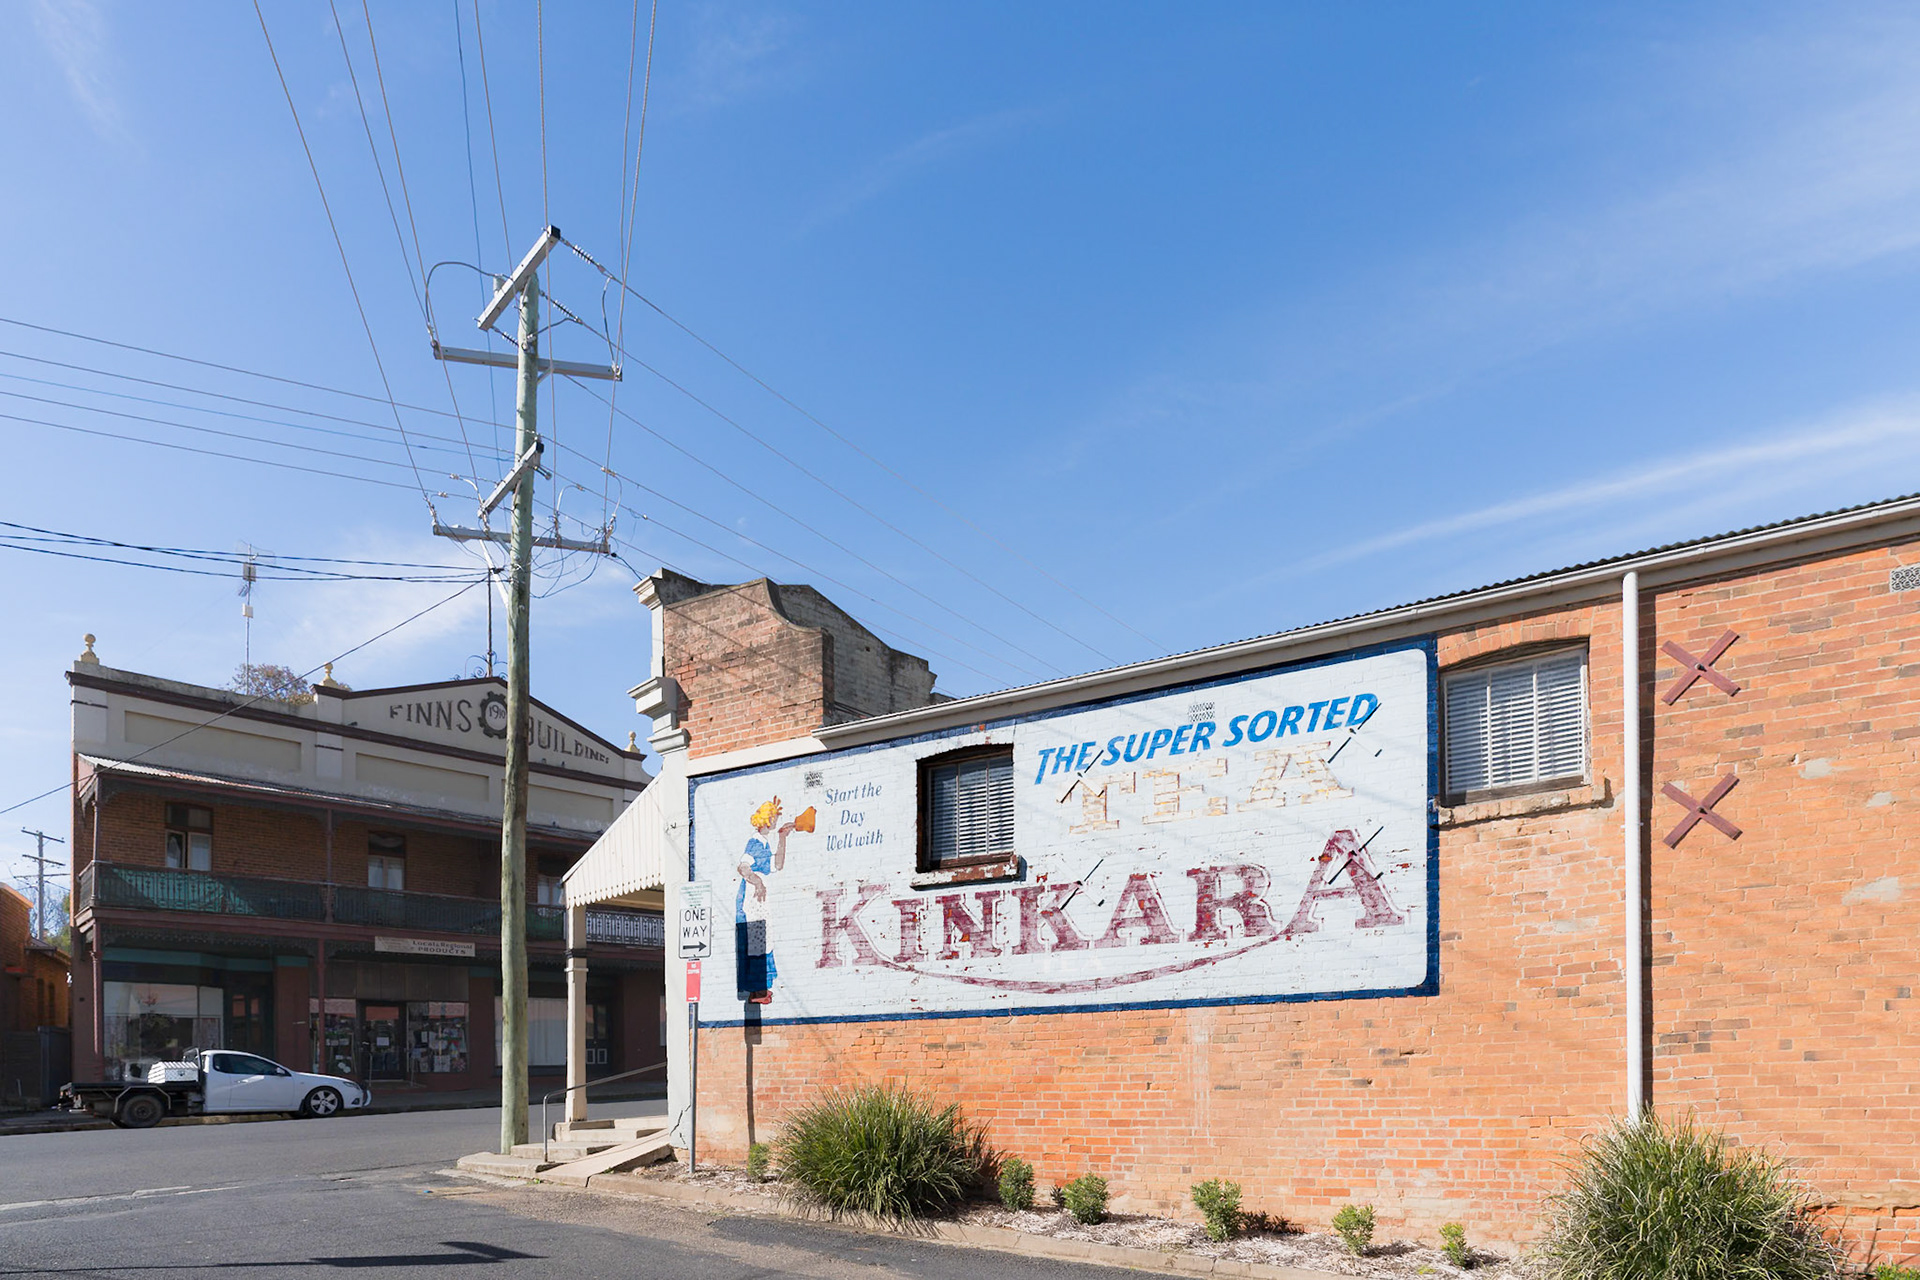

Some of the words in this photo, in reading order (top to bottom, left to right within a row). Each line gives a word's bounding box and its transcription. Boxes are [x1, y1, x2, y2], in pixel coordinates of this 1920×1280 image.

[389, 699, 473, 733] FINNS
[1035, 741, 1097, 785] THE
[1100, 721, 1217, 768] SUPER
[1222, 692, 1380, 747] SORTED
[825, 785, 859, 805] Start
[861, 781, 883, 799] the
[1060, 740, 1355, 835] TEA
[840, 809, 865, 827] Day
[826, 832, 853, 852] Well
[855, 828, 884, 847] with
[815, 828, 1410, 969] KINKARA
[684, 908, 706, 922] ONE
[683, 925, 708, 938] WAY
[418, 947, 467, 955] PRODUCTS
